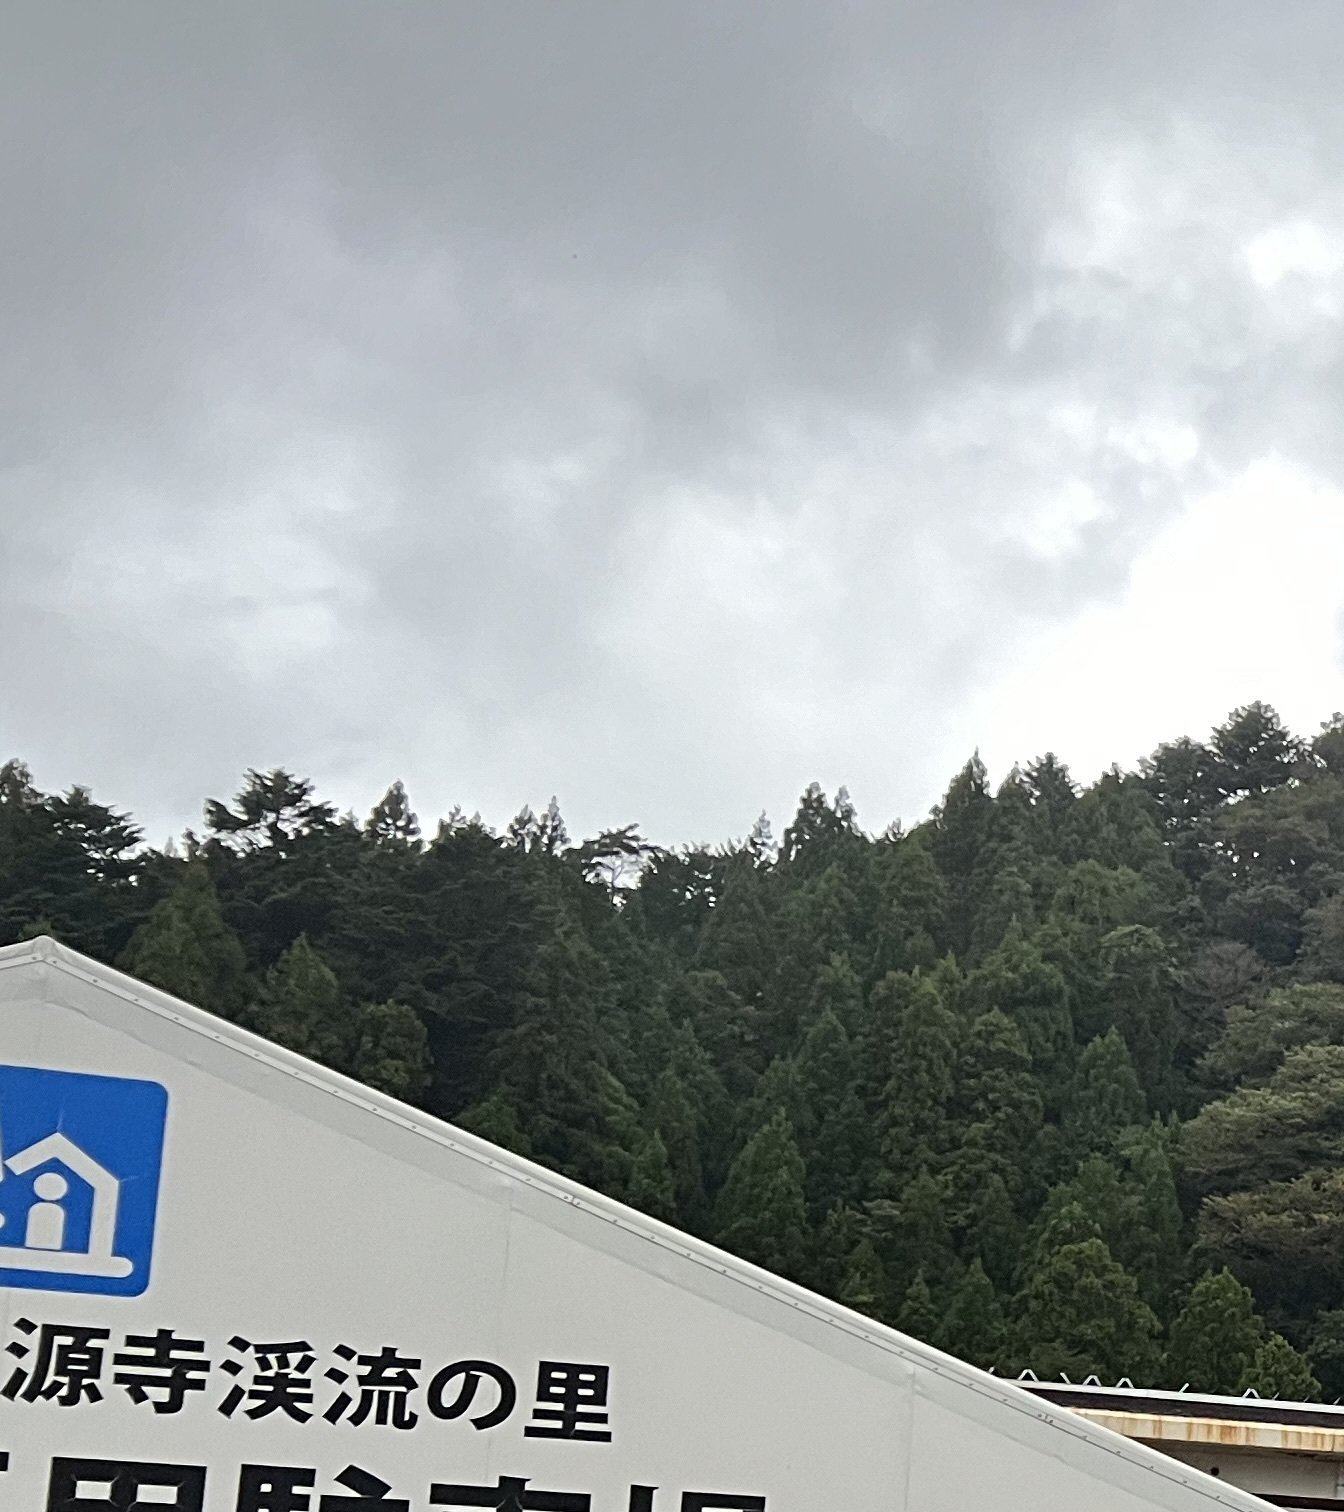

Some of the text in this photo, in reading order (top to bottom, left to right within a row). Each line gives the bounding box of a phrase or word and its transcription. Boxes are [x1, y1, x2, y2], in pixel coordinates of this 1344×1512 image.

[1, 1317, 613, 1444] 源寺渓流の里
